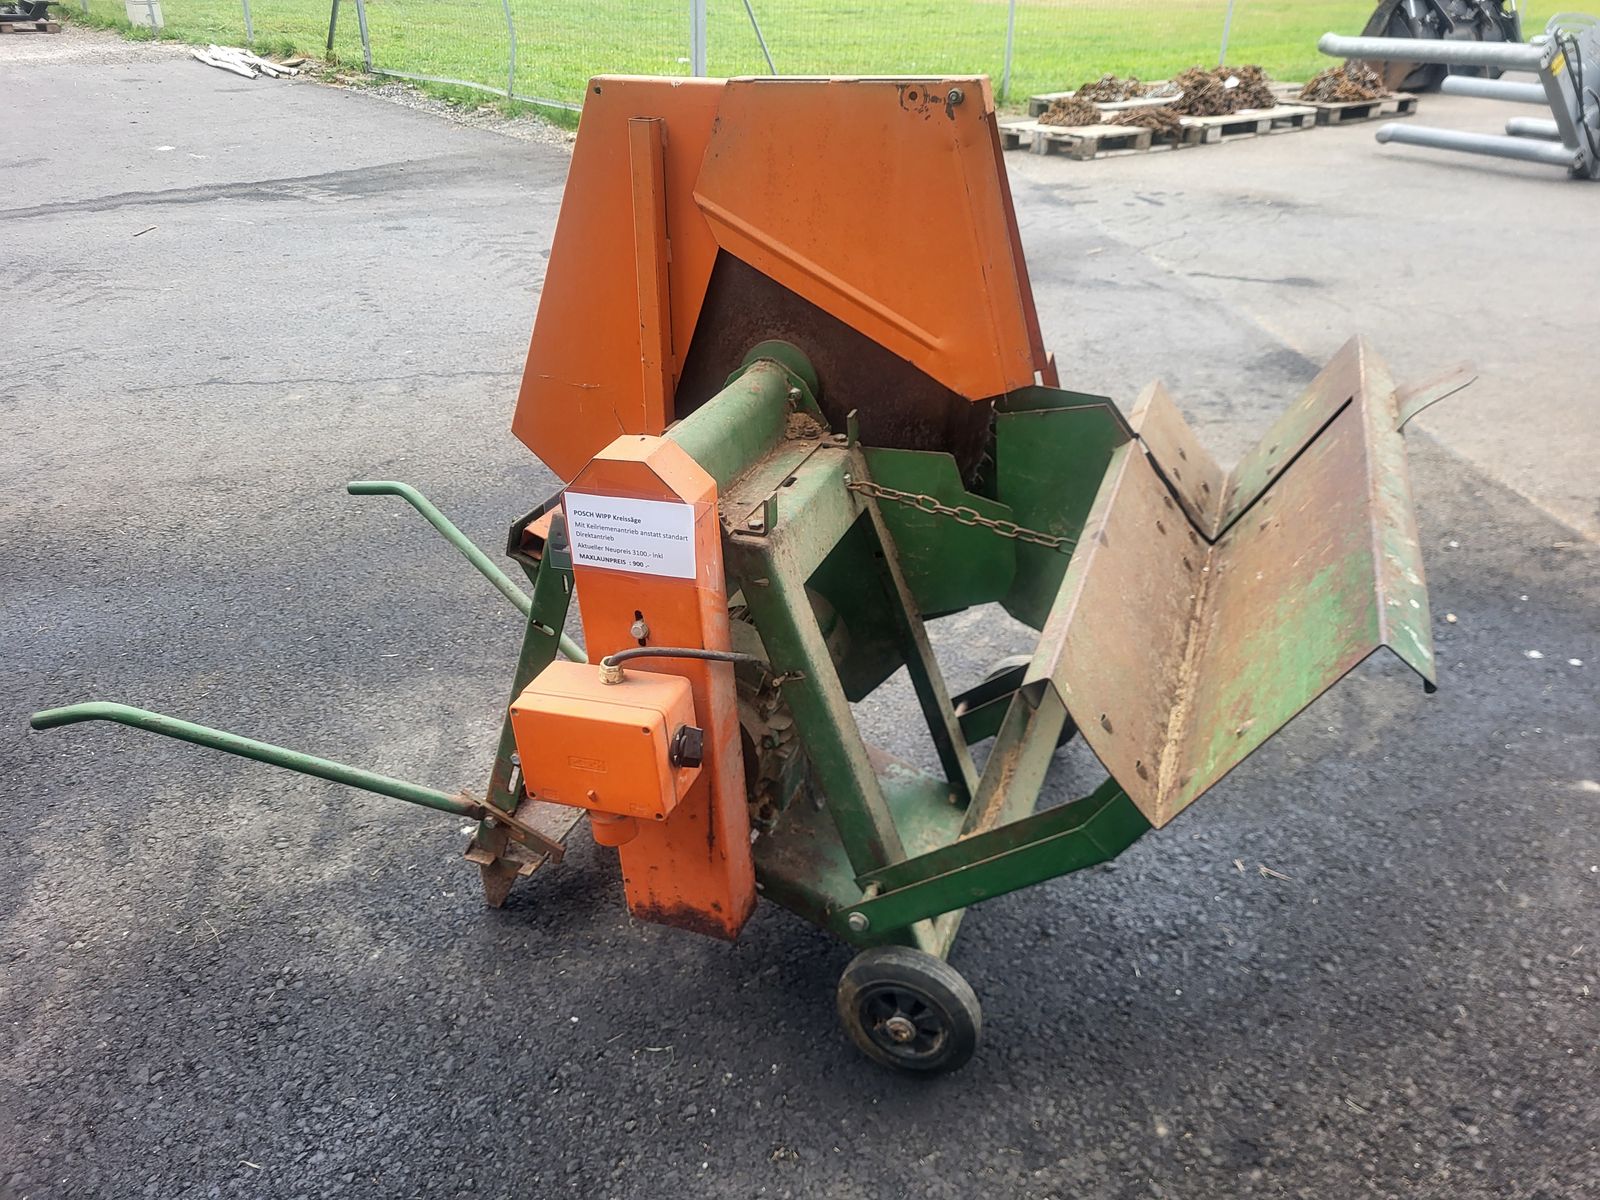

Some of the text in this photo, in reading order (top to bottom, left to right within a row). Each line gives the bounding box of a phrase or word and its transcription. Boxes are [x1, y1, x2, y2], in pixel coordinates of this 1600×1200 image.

[574, 510, 594, 518] POSCH
[613, 515, 641, 524] Kreissäge
[576, 531, 614, 541] Direktantrieb
[587, 524, 638, 535] Keilriemenantrieb
[663, 533, 688, 541] standart
[578, 542, 604, 551] Aktueller
[605, 546, 631, 556] Neupreis
